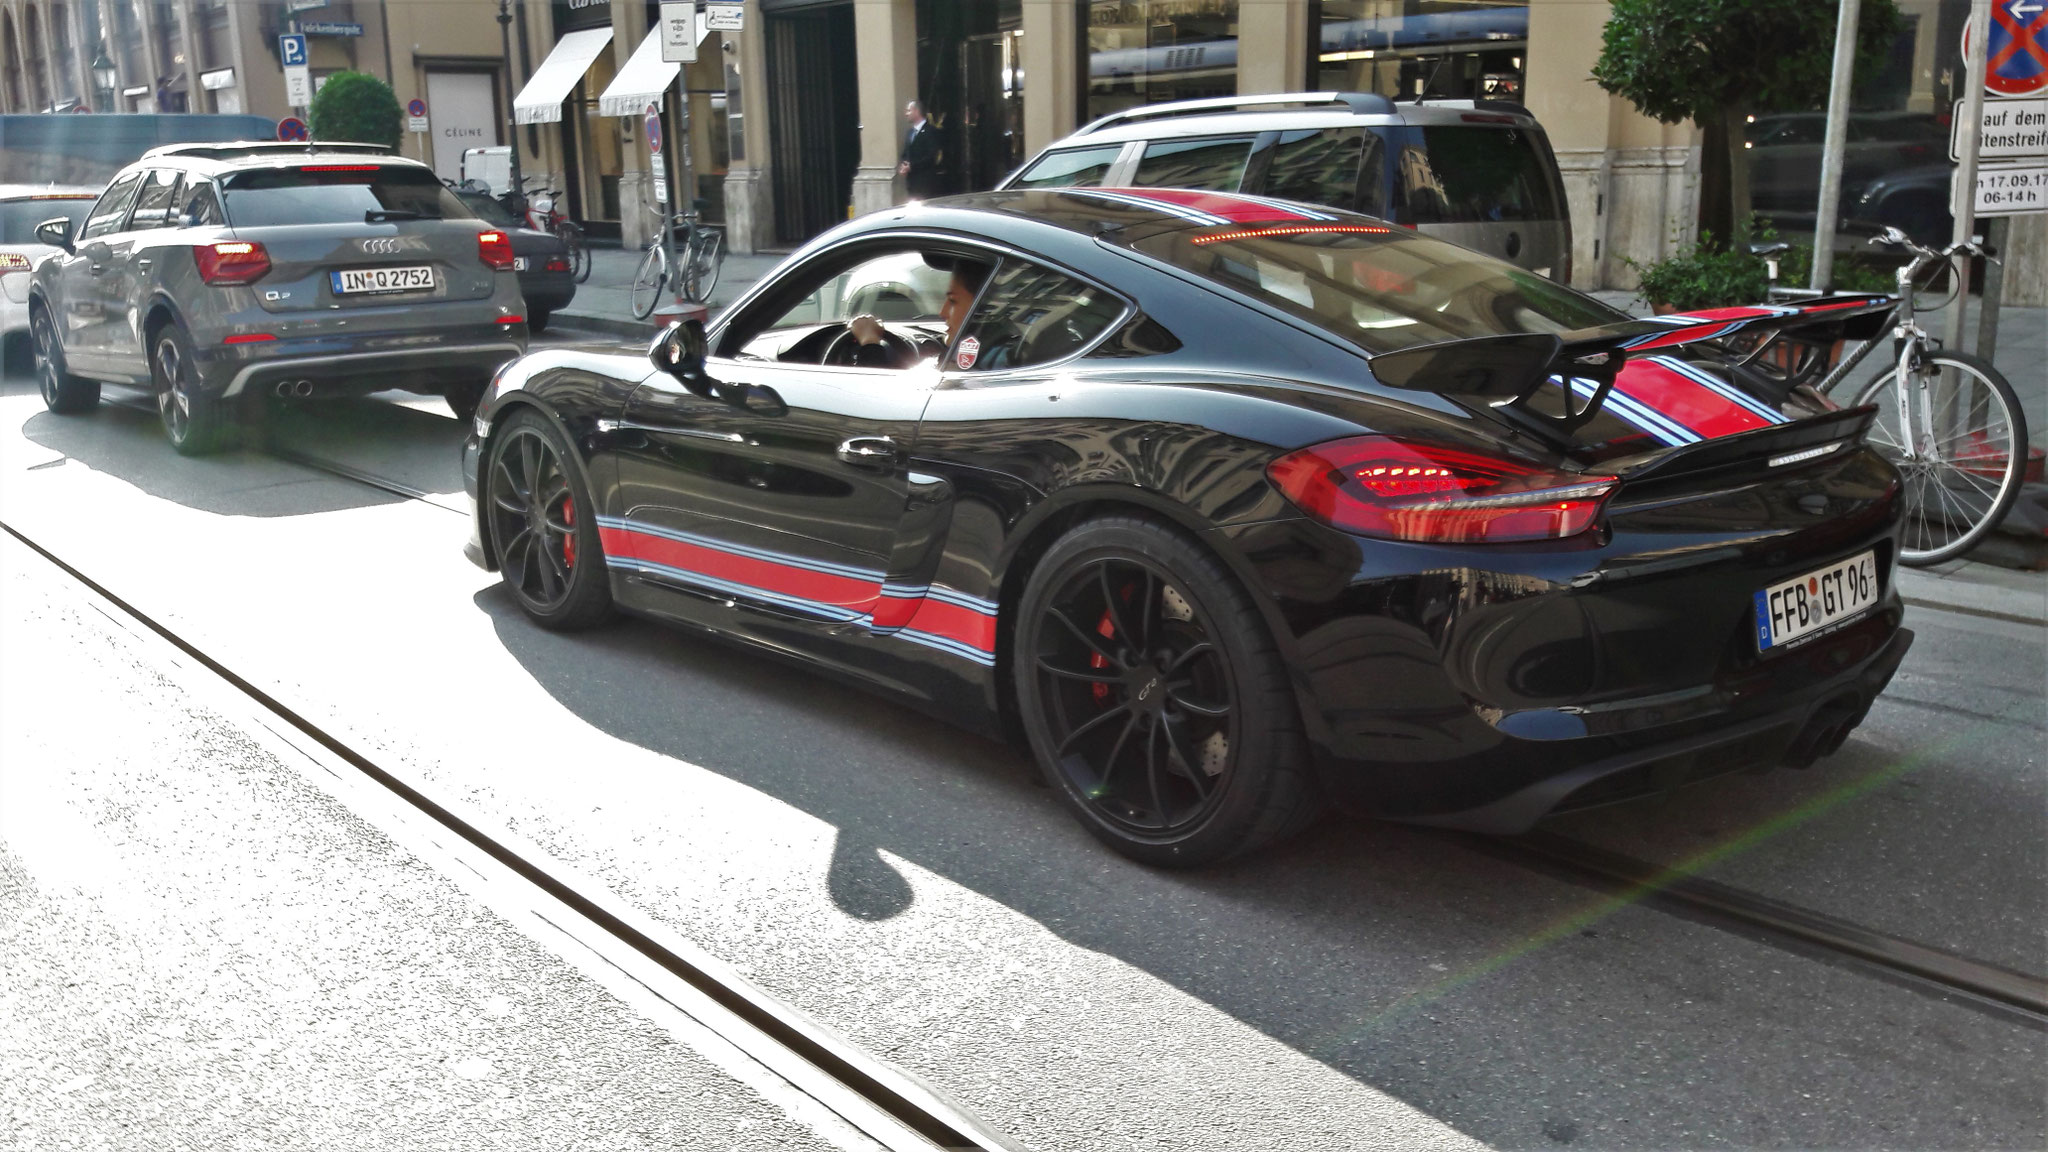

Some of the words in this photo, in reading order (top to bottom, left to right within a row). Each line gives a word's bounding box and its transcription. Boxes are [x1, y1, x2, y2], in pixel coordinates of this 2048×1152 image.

[284, 38, 299, 63] P
[1983, 110, 2008, 126] auf
[2015, 110, 2046, 126] dem
[1984, 189, 2024, 204] 06-14
[2027, 190, 2037, 202] h
[345, 273, 367, 290] IN
[376, 272, 388, 288] Q
[391, 269, 432, 287] 2752
[1770, 583, 1809, 638] FFB
[1821, 569, 1844, 617] GT
[1847, 560, 1868, 606] 96
